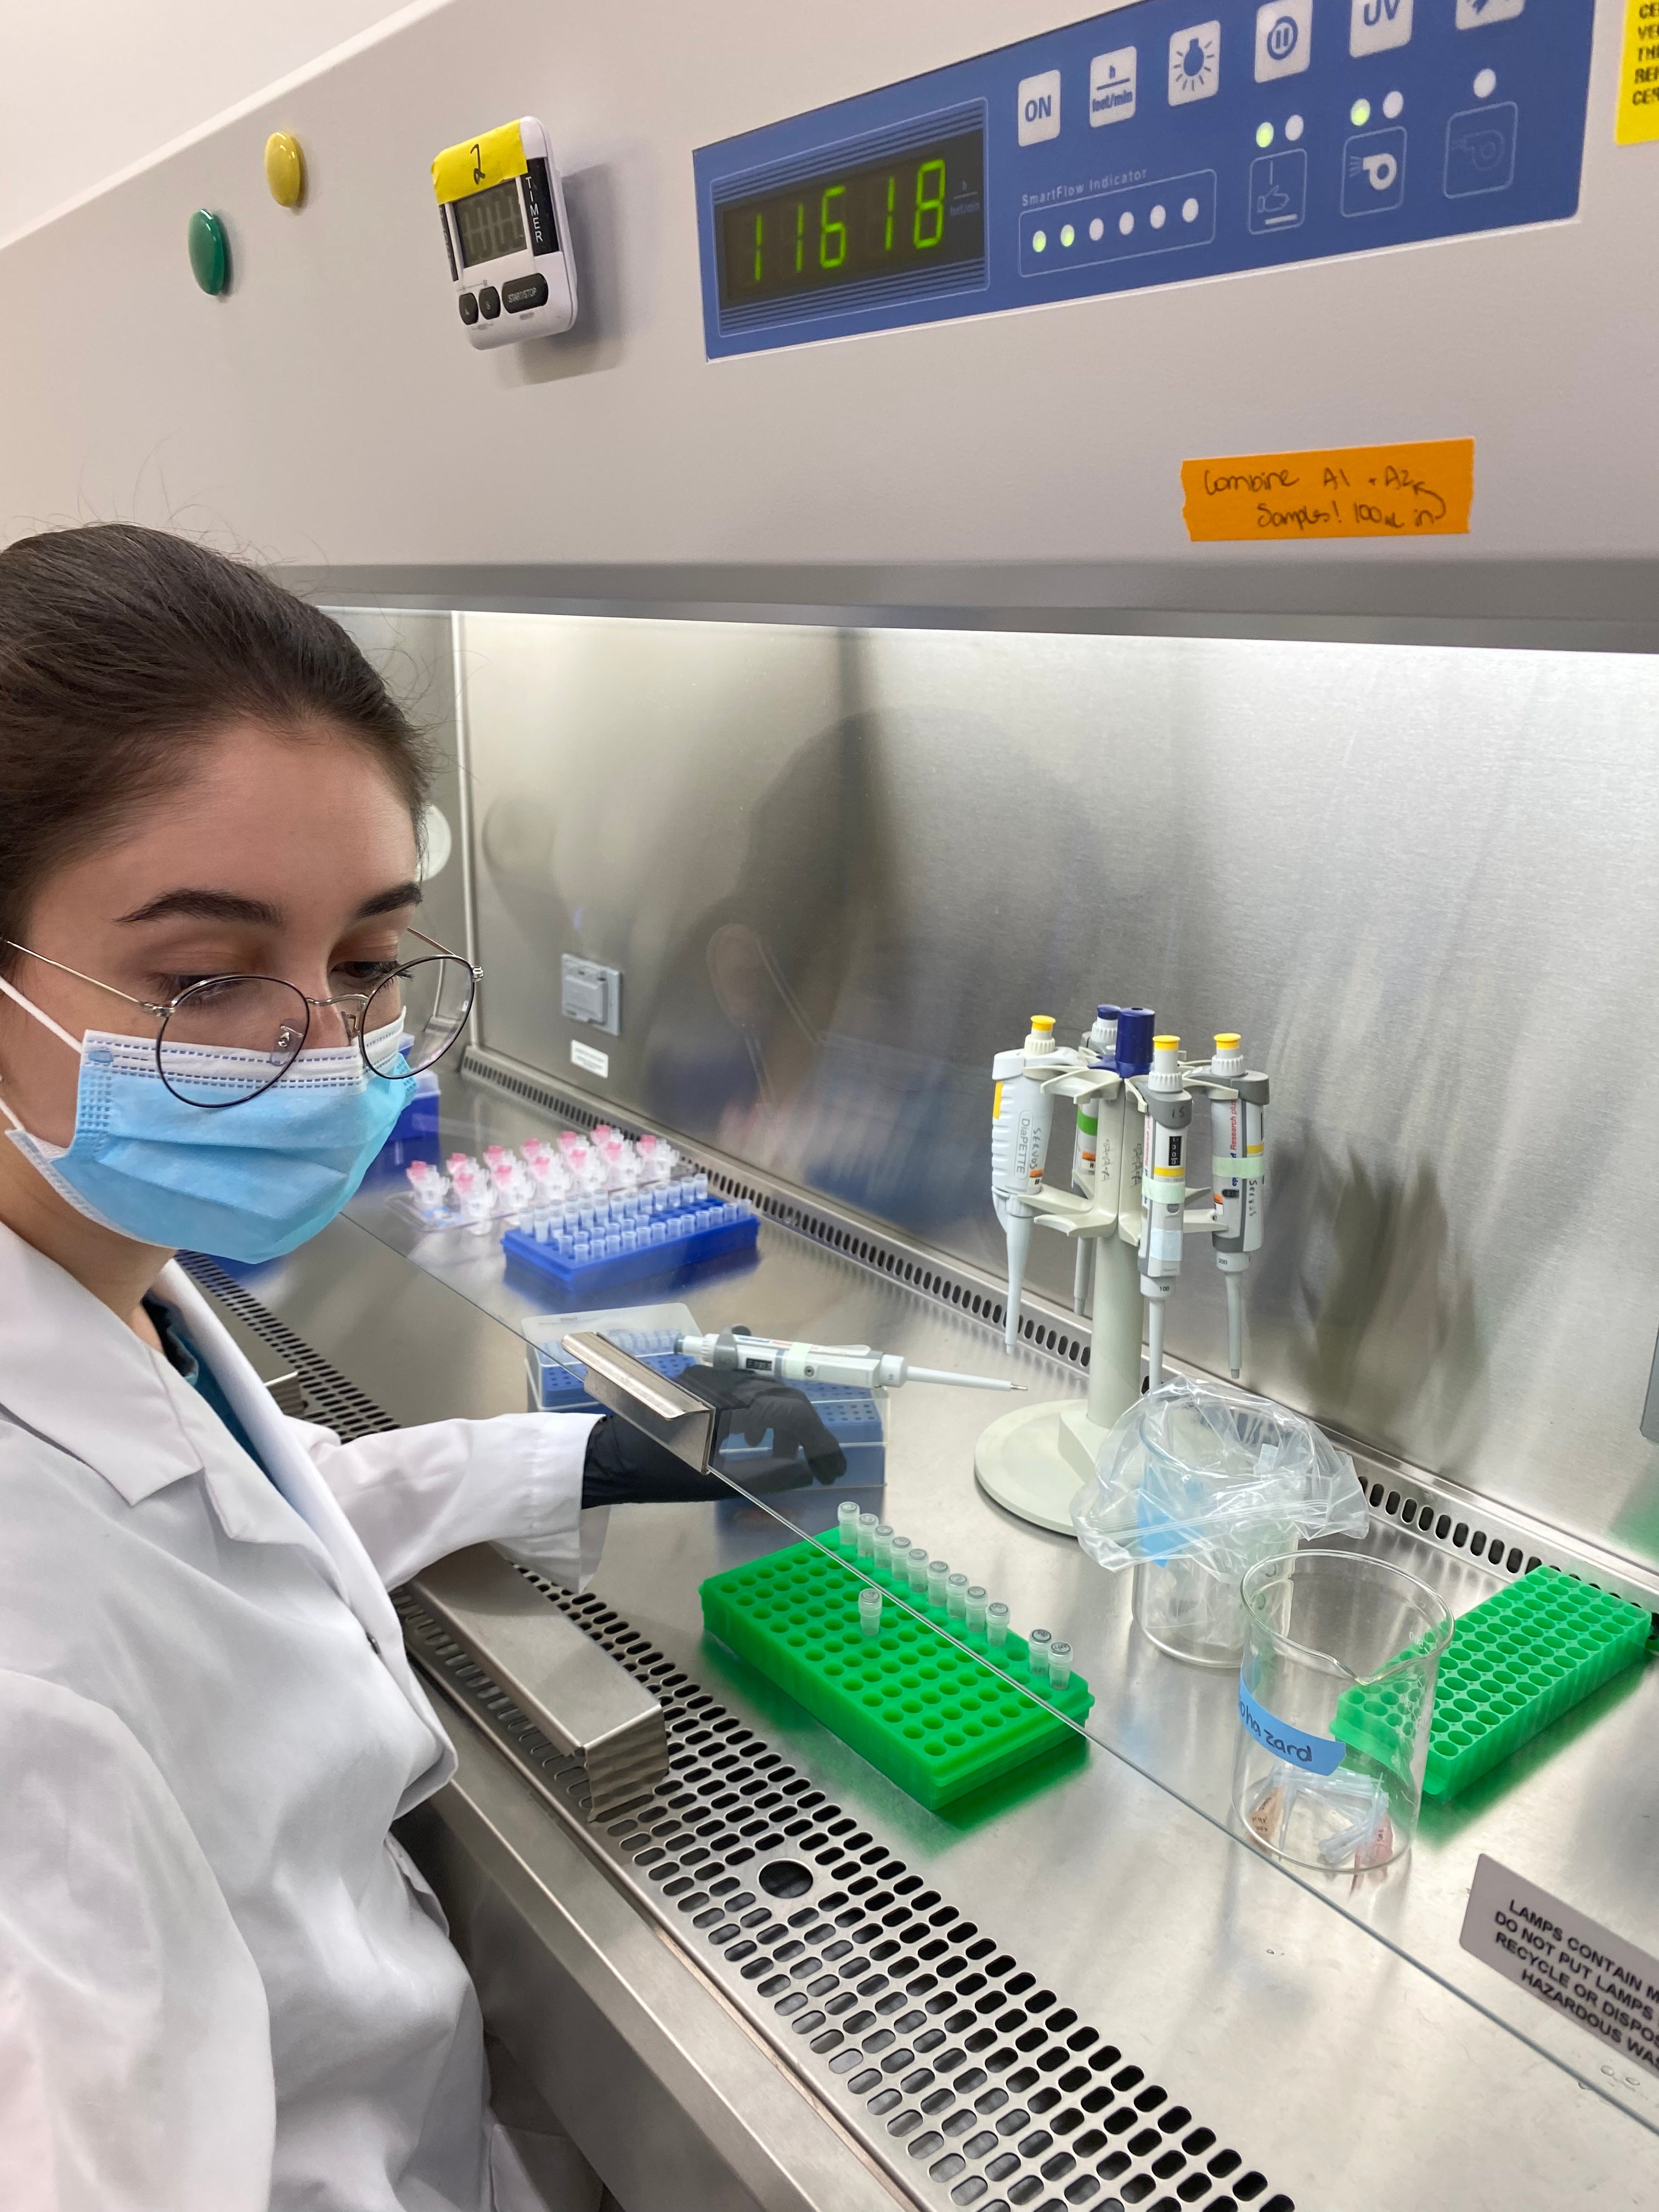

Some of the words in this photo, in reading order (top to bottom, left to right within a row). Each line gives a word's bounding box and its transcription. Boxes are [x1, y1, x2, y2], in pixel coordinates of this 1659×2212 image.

[1364, 0, 1400, 26] UV
[1025, 94, 1052, 122] ON
[1092, 89, 1133, 112] feet/min
[526, 176, 543, 243] TIMER
[1022, 184, 1085, 206] SmartFlow
[1089, 169, 1147, 191] Indicator
[754, 159, 946, 282] 11618
[1204, 469, 1300, 495] Combine
[1323, 467, 1351, 490] A1
[1385, 465, 1414, 490] A2
[1413, 508, 1435, 527] in
[1016, 1118, 1030, 1175] DiaPETTE
[1495, 1910, 1518, 1933] DO
[1522, 1928, 1556, 1957] NOT
[1559, 1951, 1593, 1980] PUT
[1596, 1974, 1654, 2021] LAMPS
[1496, 1931, 1571, 1989] RECYCLE
[1574, 1983, 1598, 2007] OR
[1509, 1899, 1563, 1942] LAMPS
[1567, 1937, 1643, 1992] CONTAIN
[1521, 1968, 1622, 2044] HAZARDOUS
